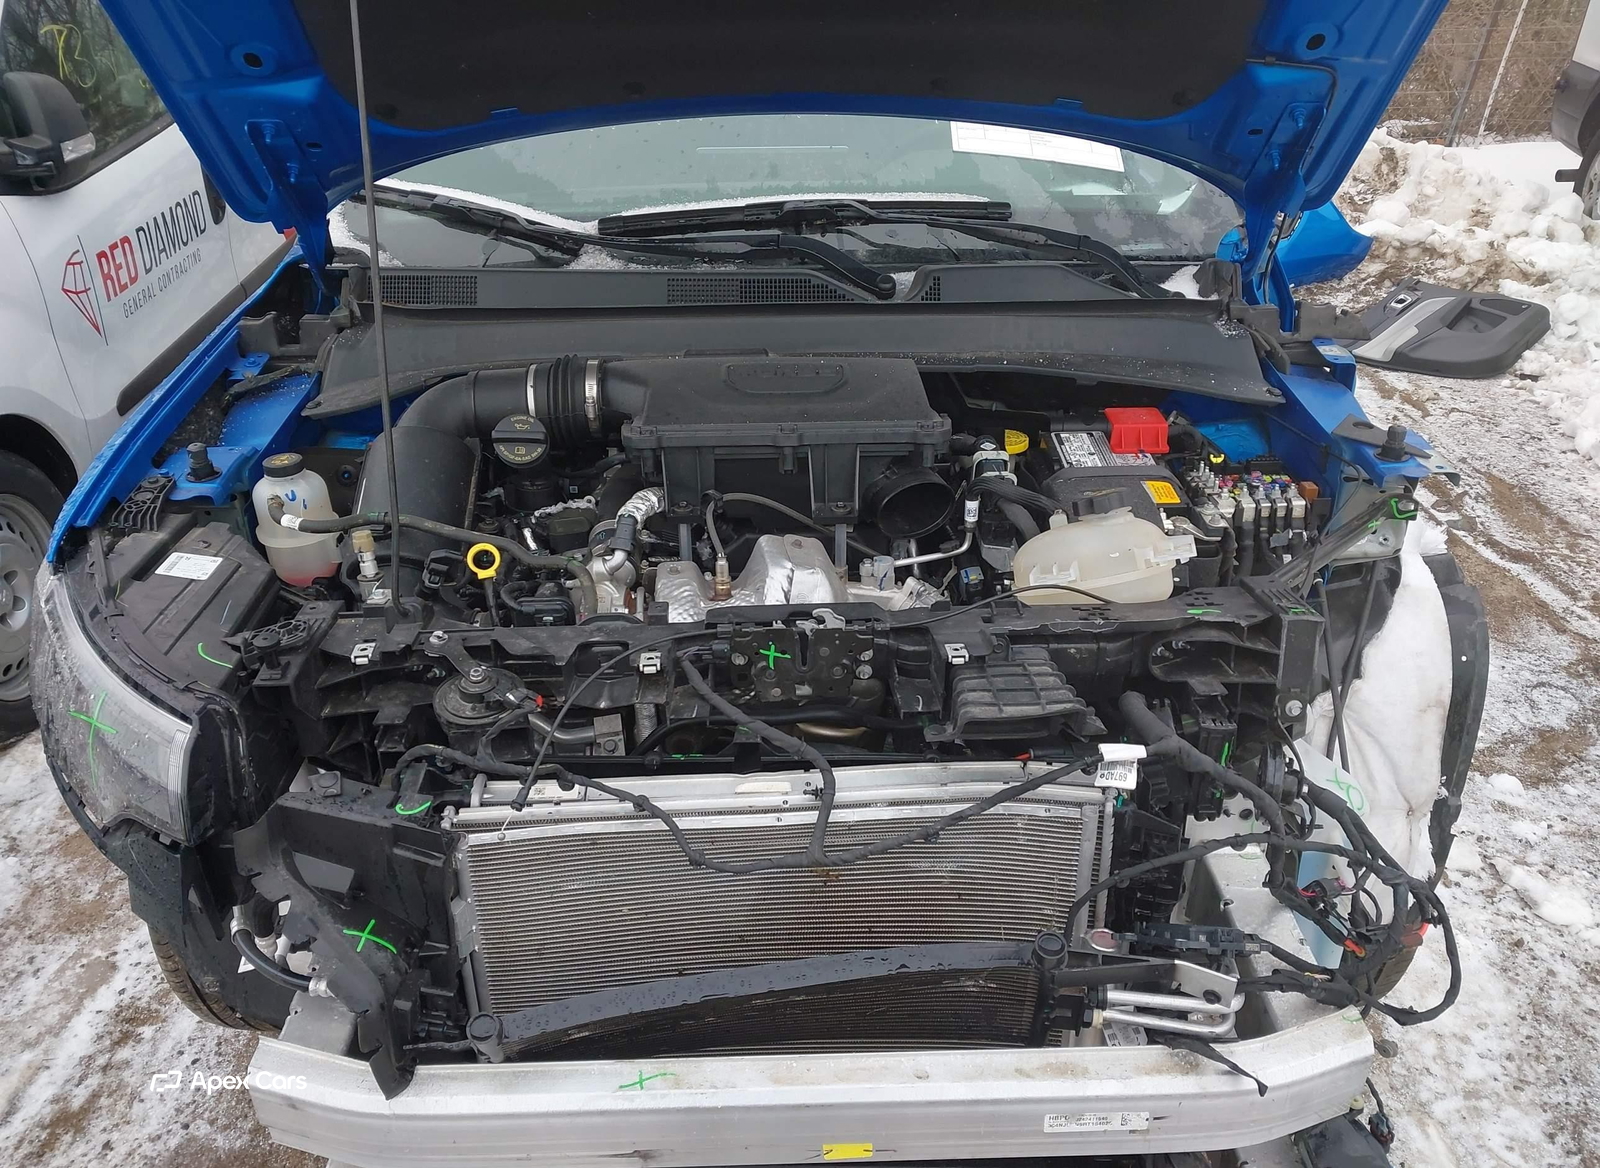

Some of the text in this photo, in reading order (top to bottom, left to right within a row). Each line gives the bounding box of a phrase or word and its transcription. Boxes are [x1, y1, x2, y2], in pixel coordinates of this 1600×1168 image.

[95, 190, 207, 302] RED DIAMOND
[122, 248, 202, 319] GENERAL CONTRACTING
